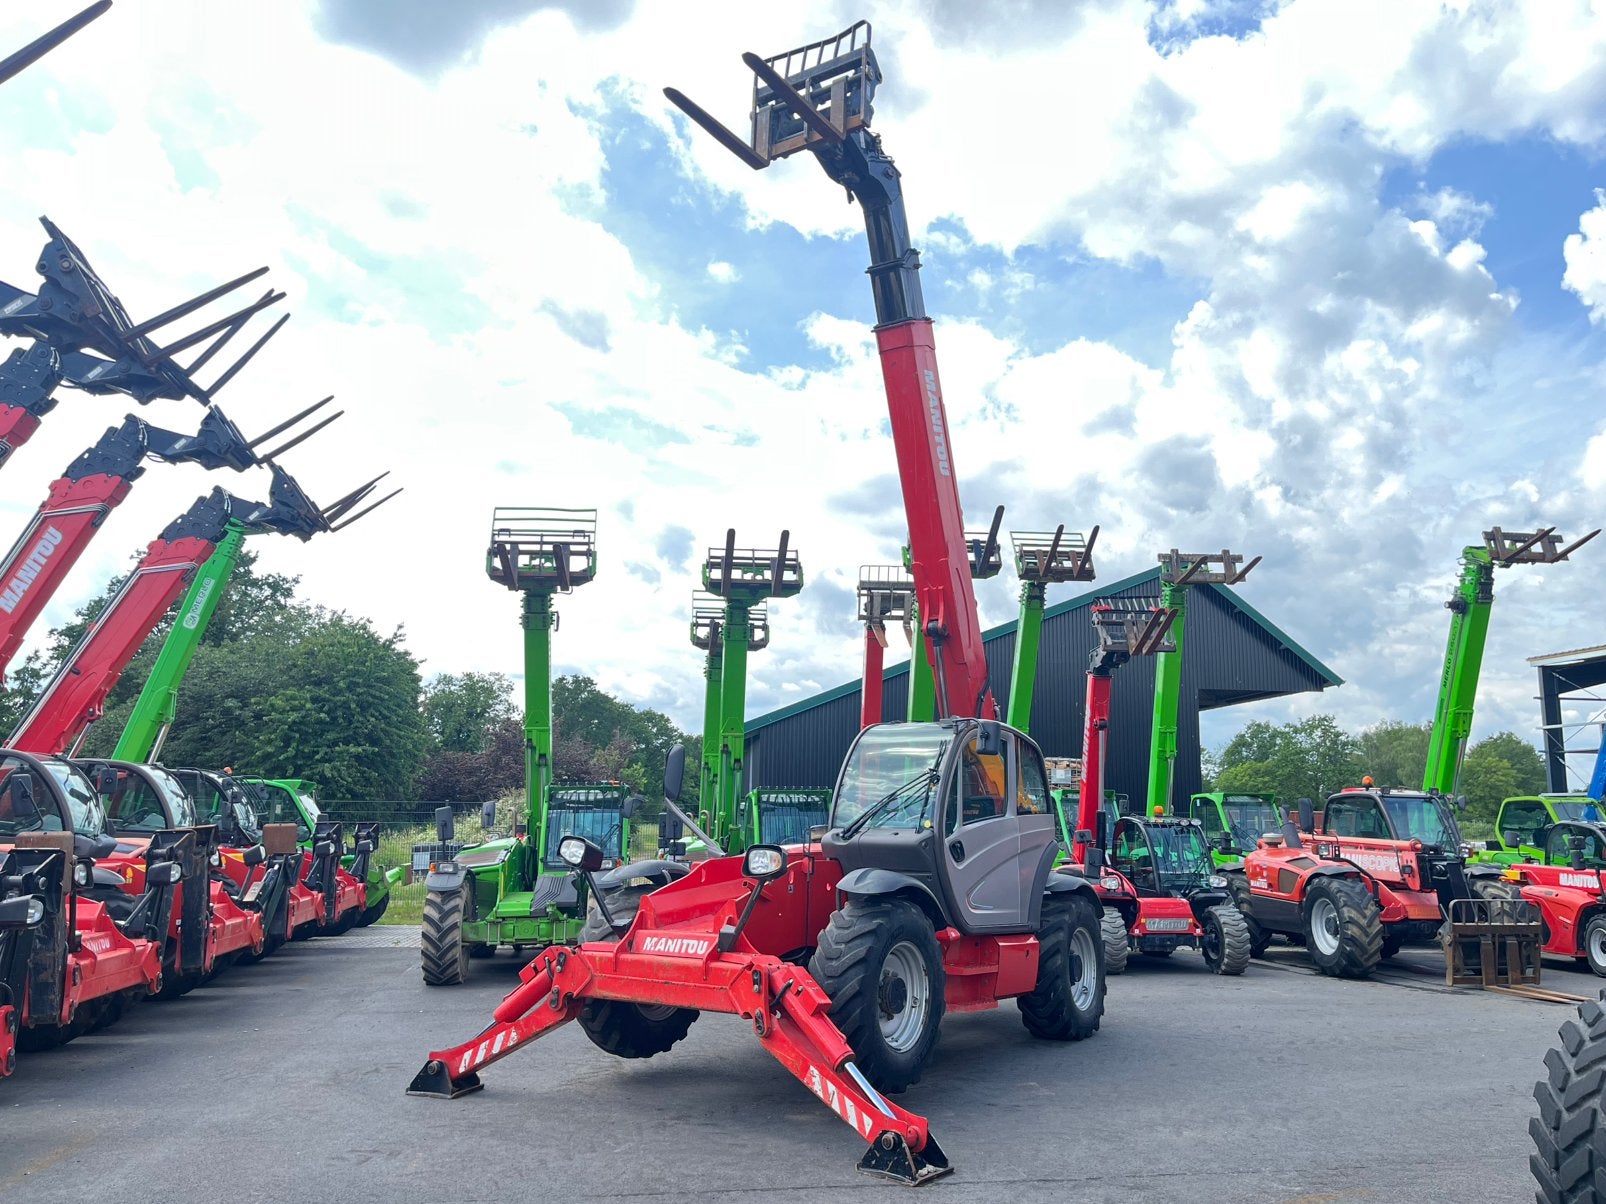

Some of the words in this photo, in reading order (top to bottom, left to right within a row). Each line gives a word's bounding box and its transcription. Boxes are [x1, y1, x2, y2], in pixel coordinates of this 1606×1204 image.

[924, 369, 950, 477] MANITOU
[0, 525, 63, 614] MANITOU
[191, 577, 212, 613] MERLO
[1442, 658, 1452, 689] MERLO
[643, 937, 709, 955] MANITOU
